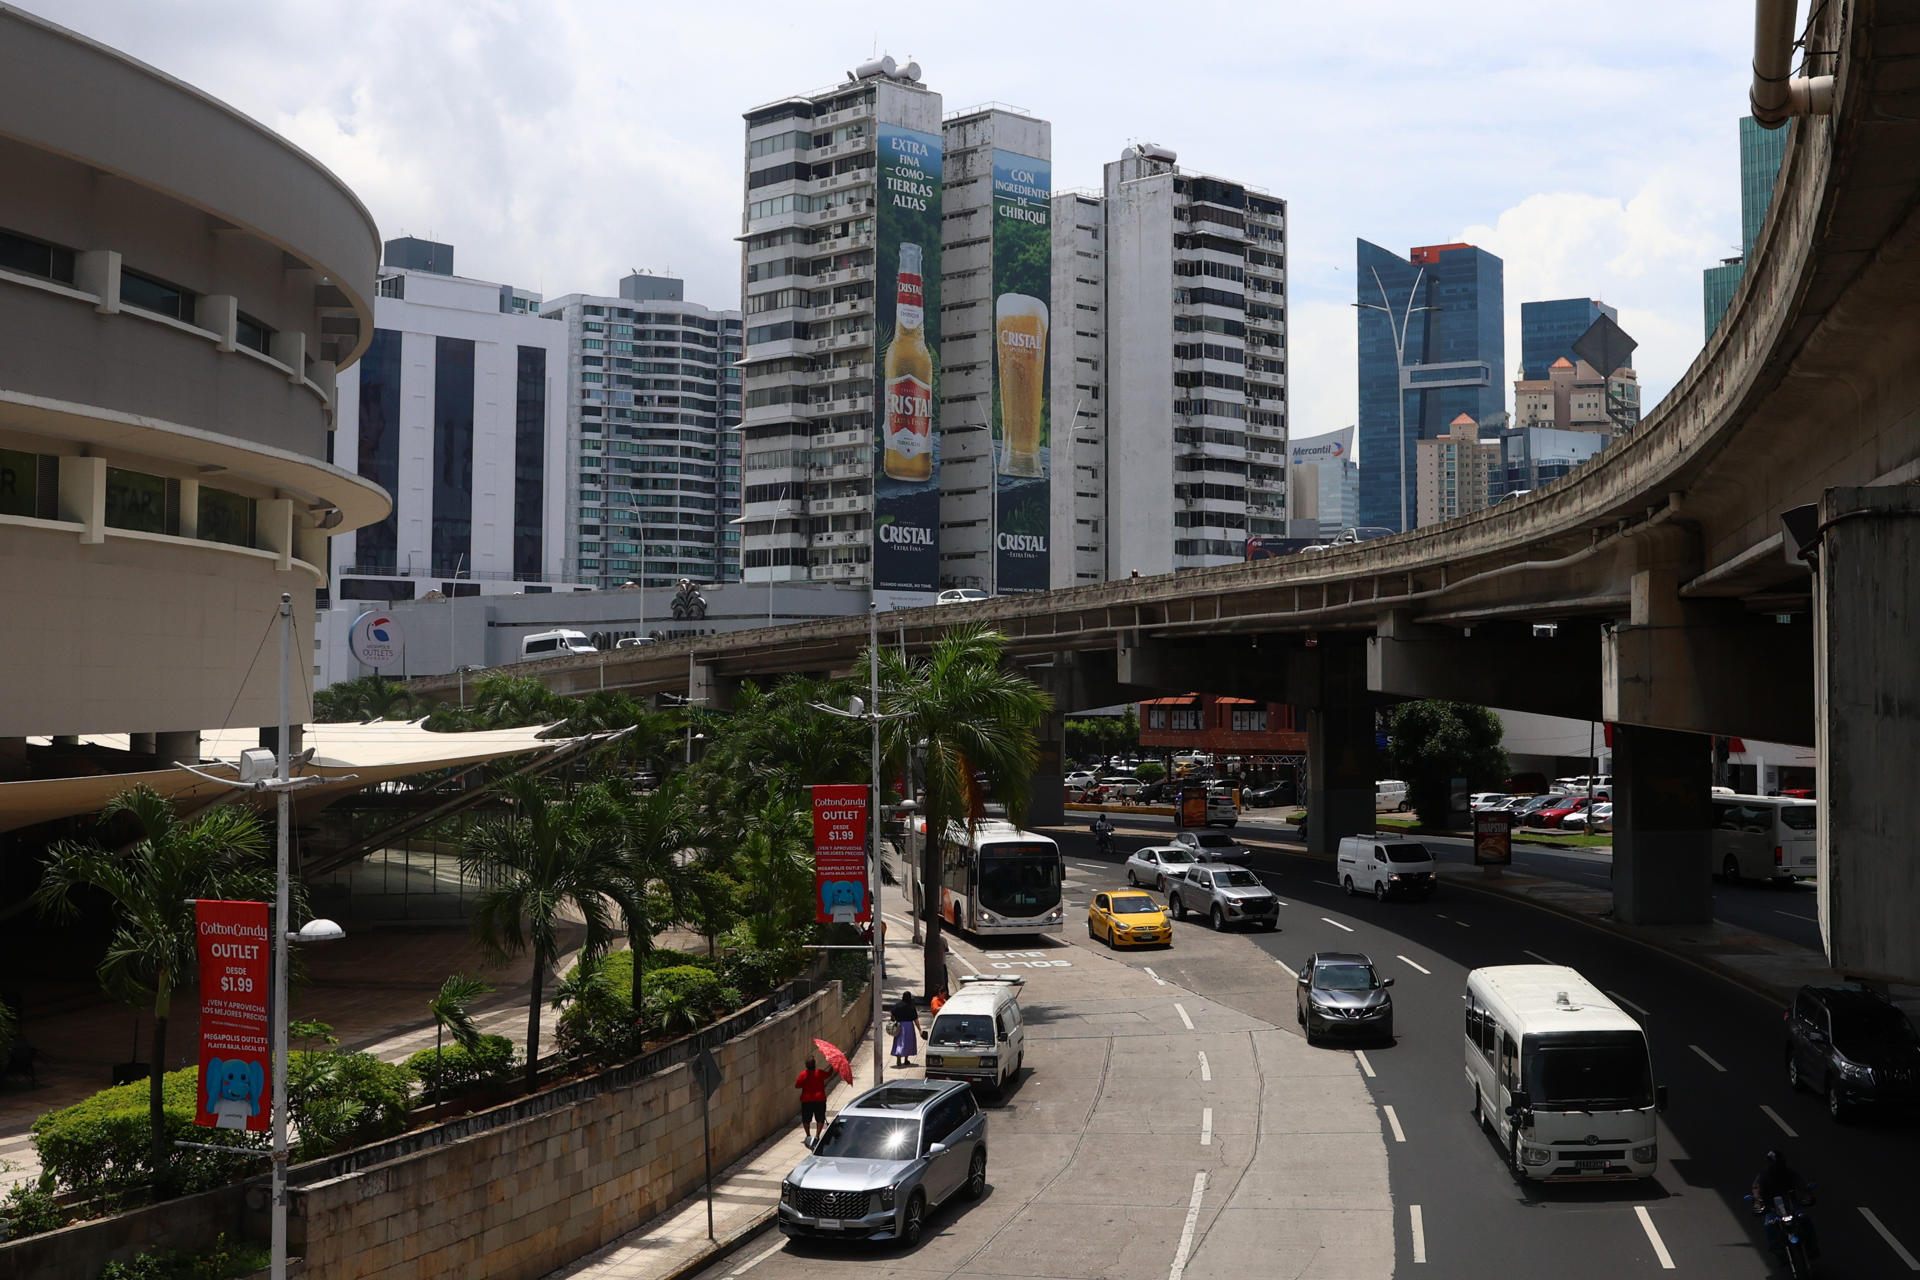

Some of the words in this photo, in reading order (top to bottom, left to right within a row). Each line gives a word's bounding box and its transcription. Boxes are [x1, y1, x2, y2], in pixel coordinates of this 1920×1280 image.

[892, 138, 928, 157] EXTRA
[900, 154, 920, 167] FINA
[895, 166, 925, 181] COMO
[1011, 169, 1034, 185] CON
[886, 177, 933, 198] TIERRAS
[995, 179, 1050, 200] INGREDIENTES
[892, 194, 927, 212] ALTAS
[1017, 196, 1028, 207] DE
[1001, 330, 1042, 350] CRISTAL
[1293, 445, 1331, 456] Mercantil
[880, 524, 934, 545] CRISTAL
[997, 532, 1047, 552] CRISTAL
[363, 649, 393, 657] OUTLETS
[815, 798, 866, 808] CottonCandy
[822, 811, 859, 820] OUTLET
[828, 830, 854, 841] $1.99
[200, 921, 268, 941] CottonCandy
[211, 943, 259, 960] OUTLET
[226, 966, 247, 976] DESDE
[991, 960, 1073, 969] SOLO
[220, 976, 253, 993] $1.99
[202, 1006, 214, 1014] LOS
[214, 1008, 242, 1018] MEJORES
[228, 1002, 265, 1013] APROVECHA
